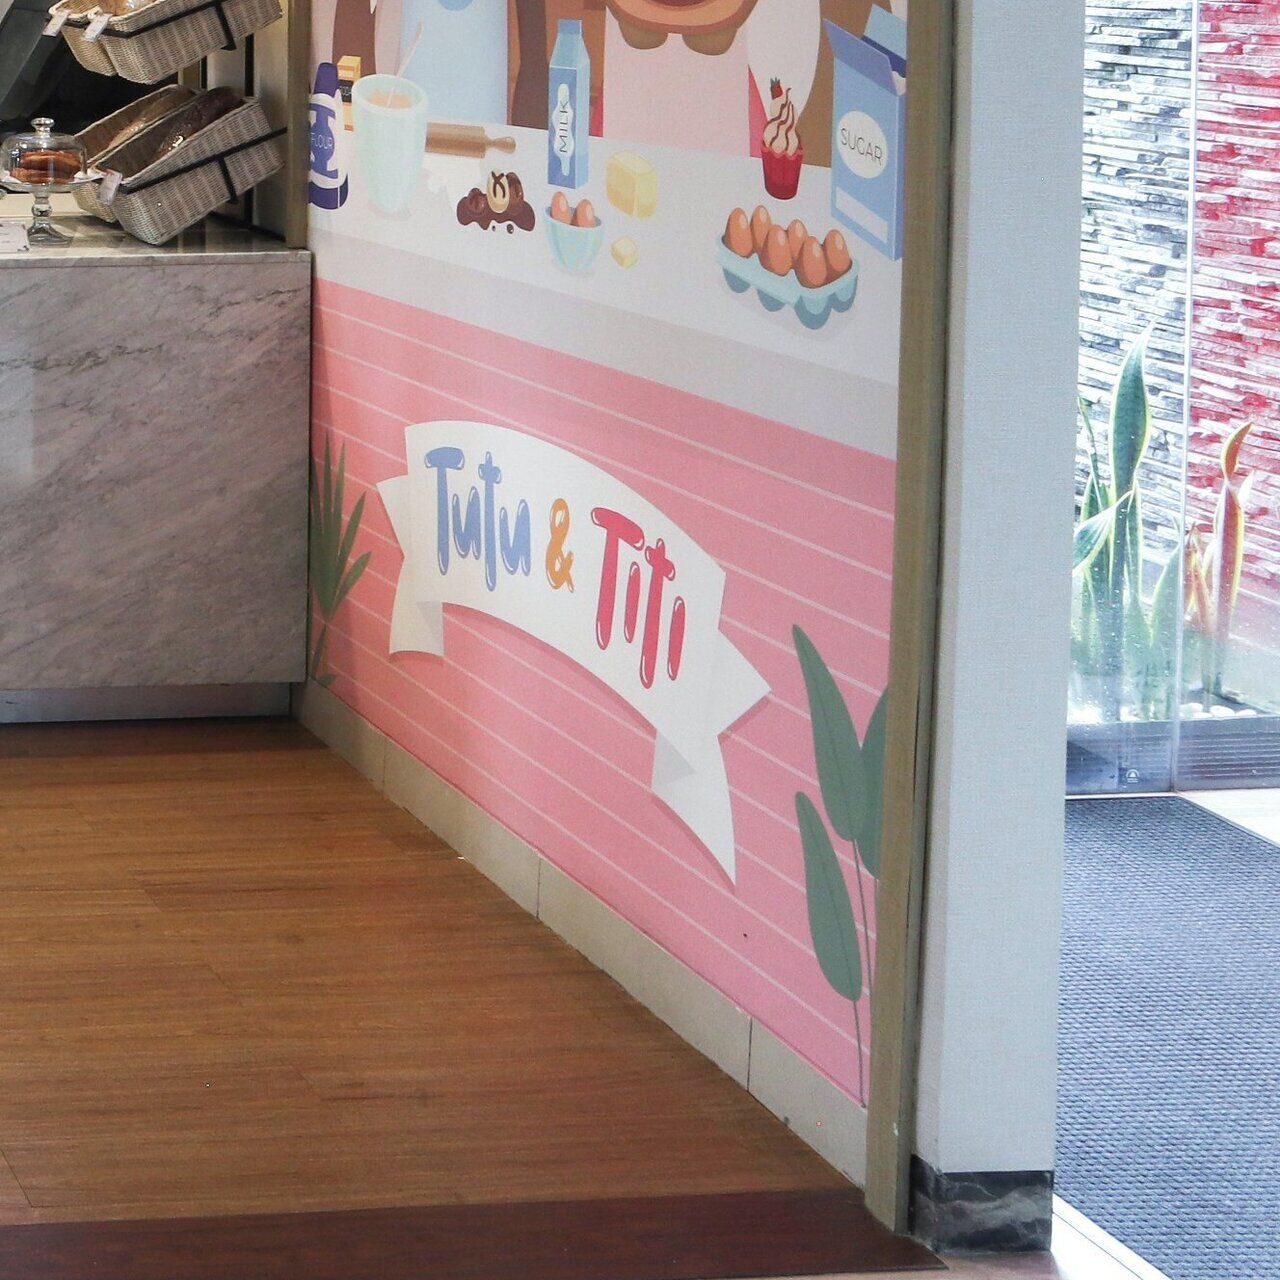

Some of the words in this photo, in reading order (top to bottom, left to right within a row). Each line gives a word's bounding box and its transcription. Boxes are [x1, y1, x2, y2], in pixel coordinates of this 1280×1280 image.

[559, 100, 568, 153] MILK
[841, 128, 883, 167] SUGAR
[424, 446, 532, 592] Tutu
[545, 498, 575, 593] &
[589, 506, 686, 690] Titi
